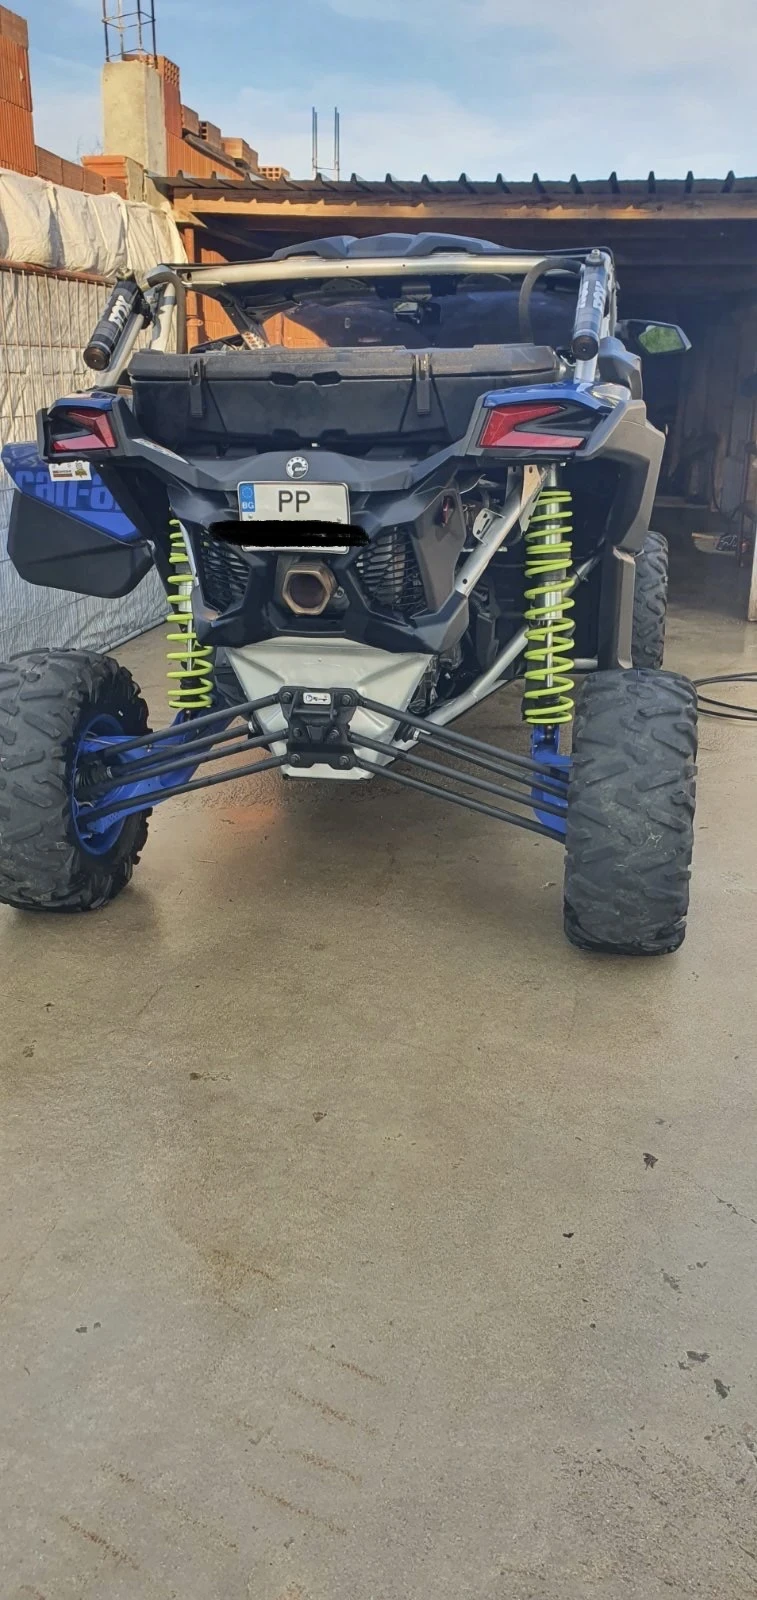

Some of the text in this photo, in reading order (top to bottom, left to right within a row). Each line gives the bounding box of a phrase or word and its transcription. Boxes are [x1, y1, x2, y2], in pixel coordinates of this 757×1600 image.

[15, 470, 122, 511] can-a
[278, 490, 311, 513] PP
[242, 501, 255, 510] BG
